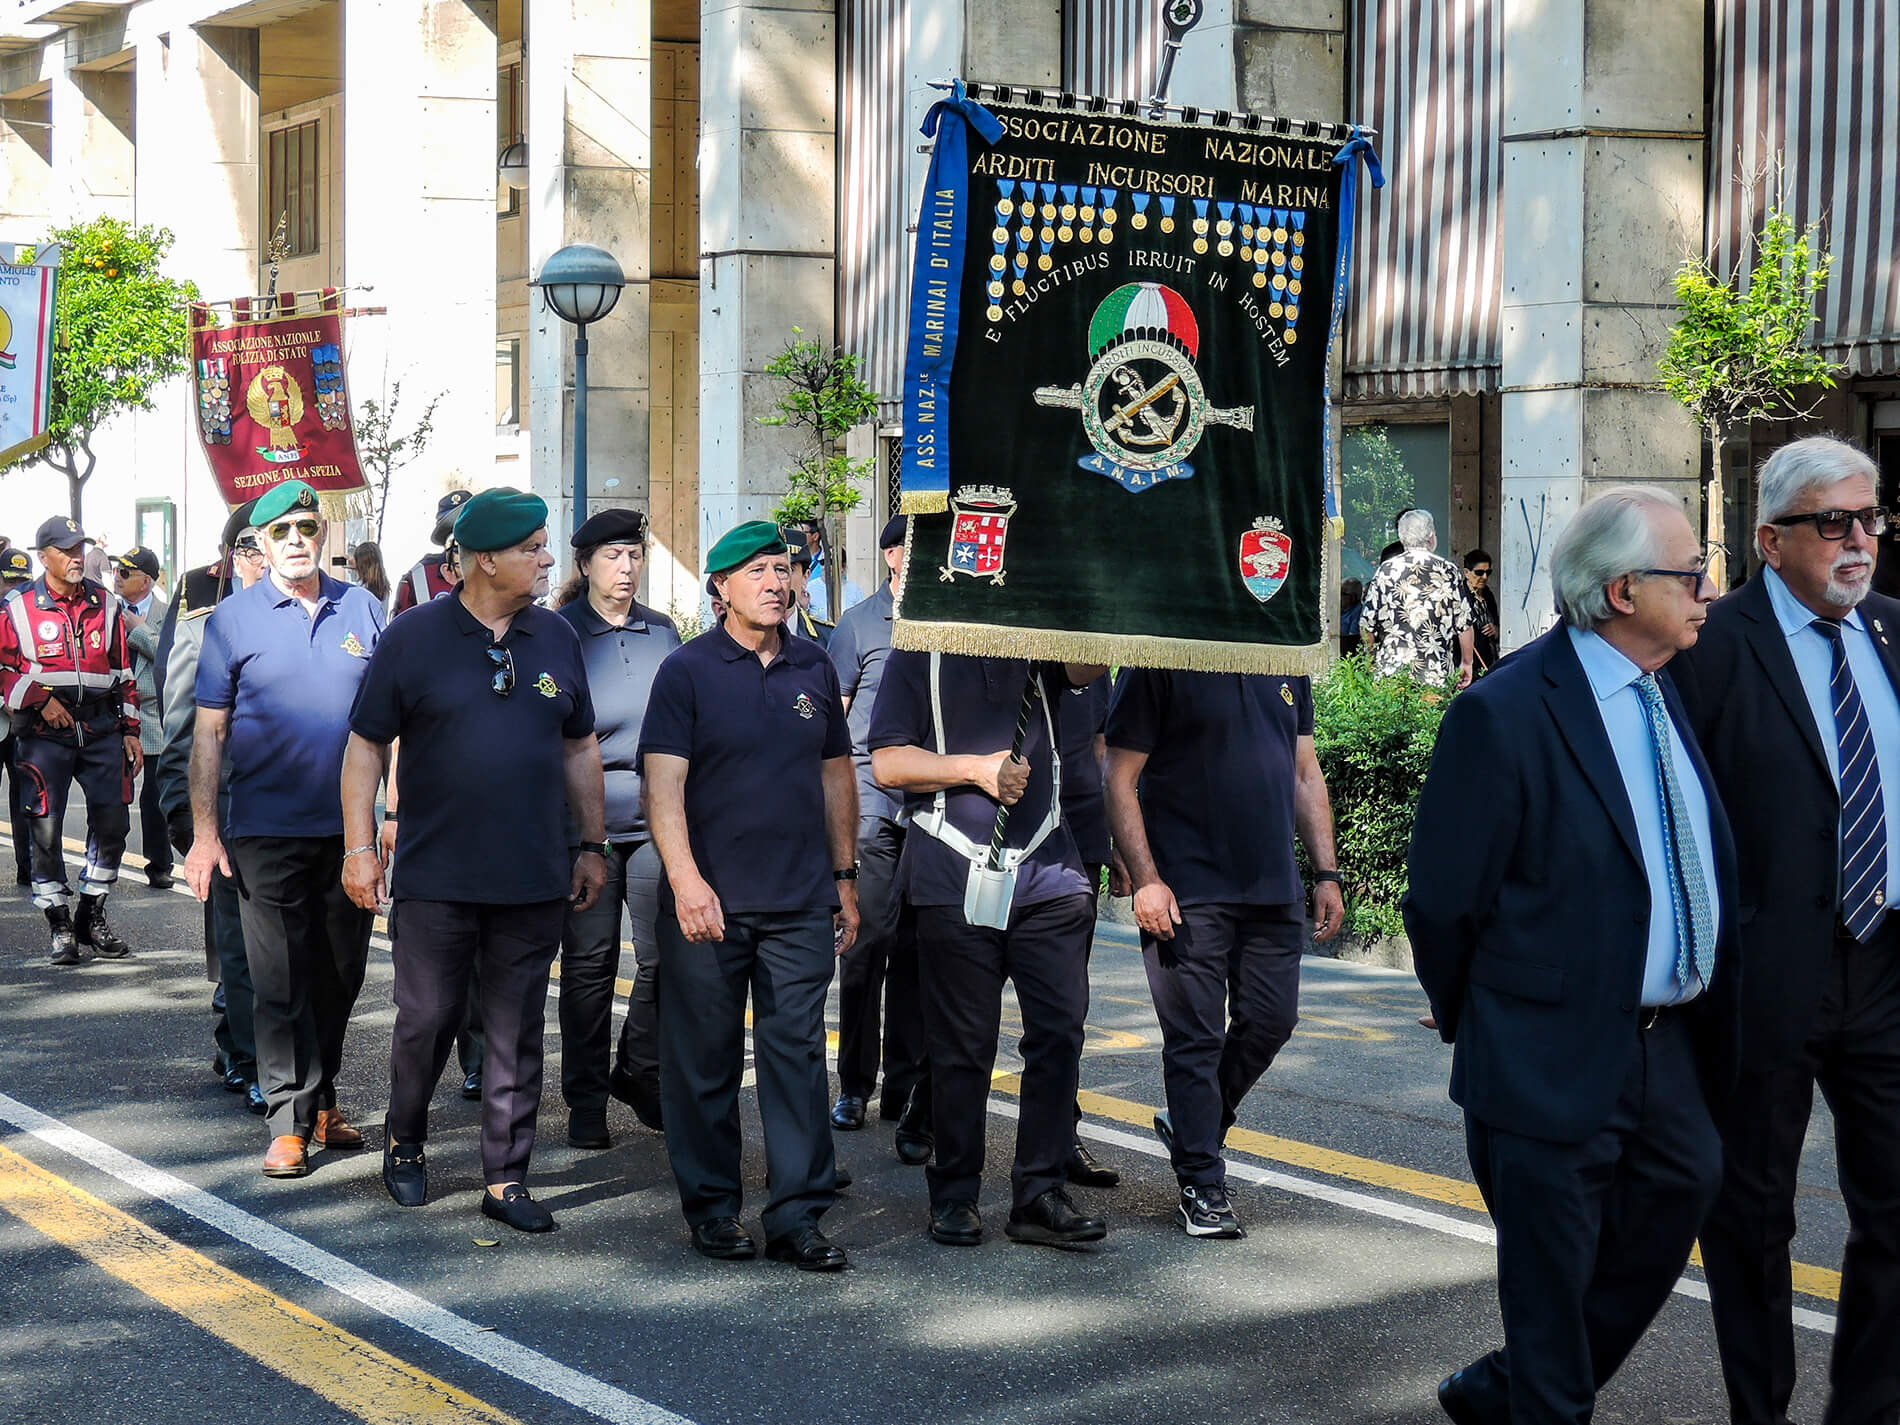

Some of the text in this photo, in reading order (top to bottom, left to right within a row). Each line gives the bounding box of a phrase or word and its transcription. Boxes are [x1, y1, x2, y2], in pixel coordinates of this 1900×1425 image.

[997, 115, 1333, 172] SSOCIAZIONE NAZIONALE
[972, 152, 1330, 209] ARDITI INCURSORI MARINA
[930, 188, 955, 268] D'ITALIA
[923, 280, 948, 357] MARINAI
[985, 250, 1291, 368] E FLUCTIBUS IRRUIT IN HOSTEM
[211, 335, 273, 353] ASSOCIAZIONE
[267, 348, 277, 361] DI
[1100, 343, 1195, 381] ARDITI INCURSORI
[916, 429, 936, 468] ASS.
[234, 464, 342, 489] SEZIONE DI LA SPEZIA
